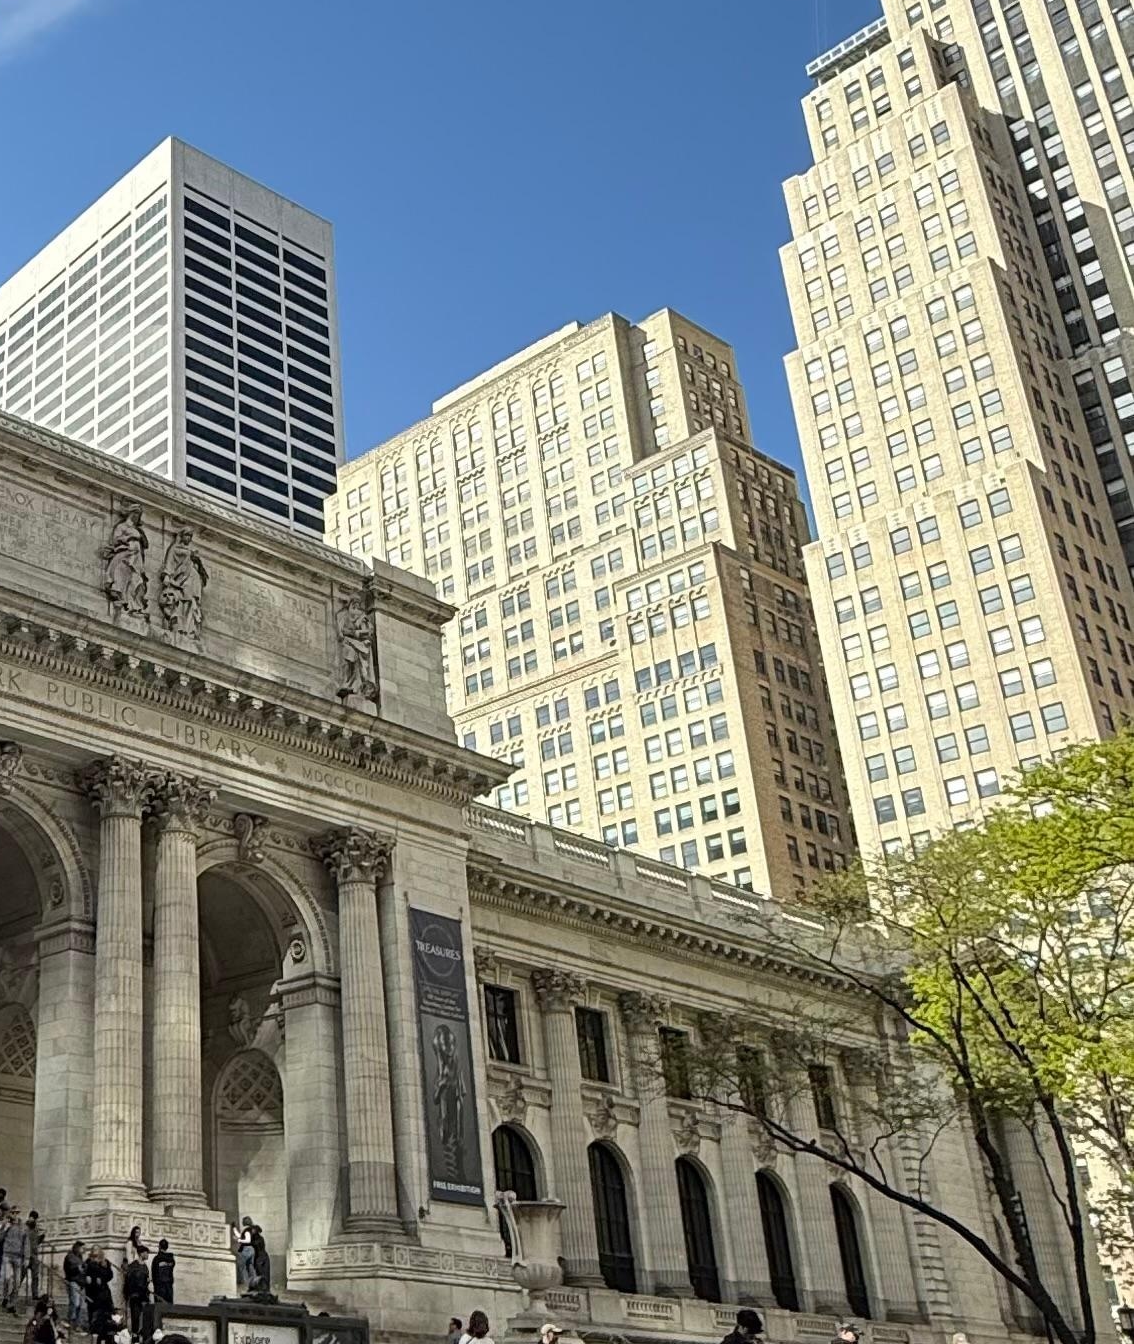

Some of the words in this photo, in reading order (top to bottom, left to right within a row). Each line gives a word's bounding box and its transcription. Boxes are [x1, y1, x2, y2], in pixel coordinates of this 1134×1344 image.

[47, 681, 137, 726] PUBLIC
[160, 717, 257, 757] LIBRARY
[415, 939, 461, 960] TREASURES
